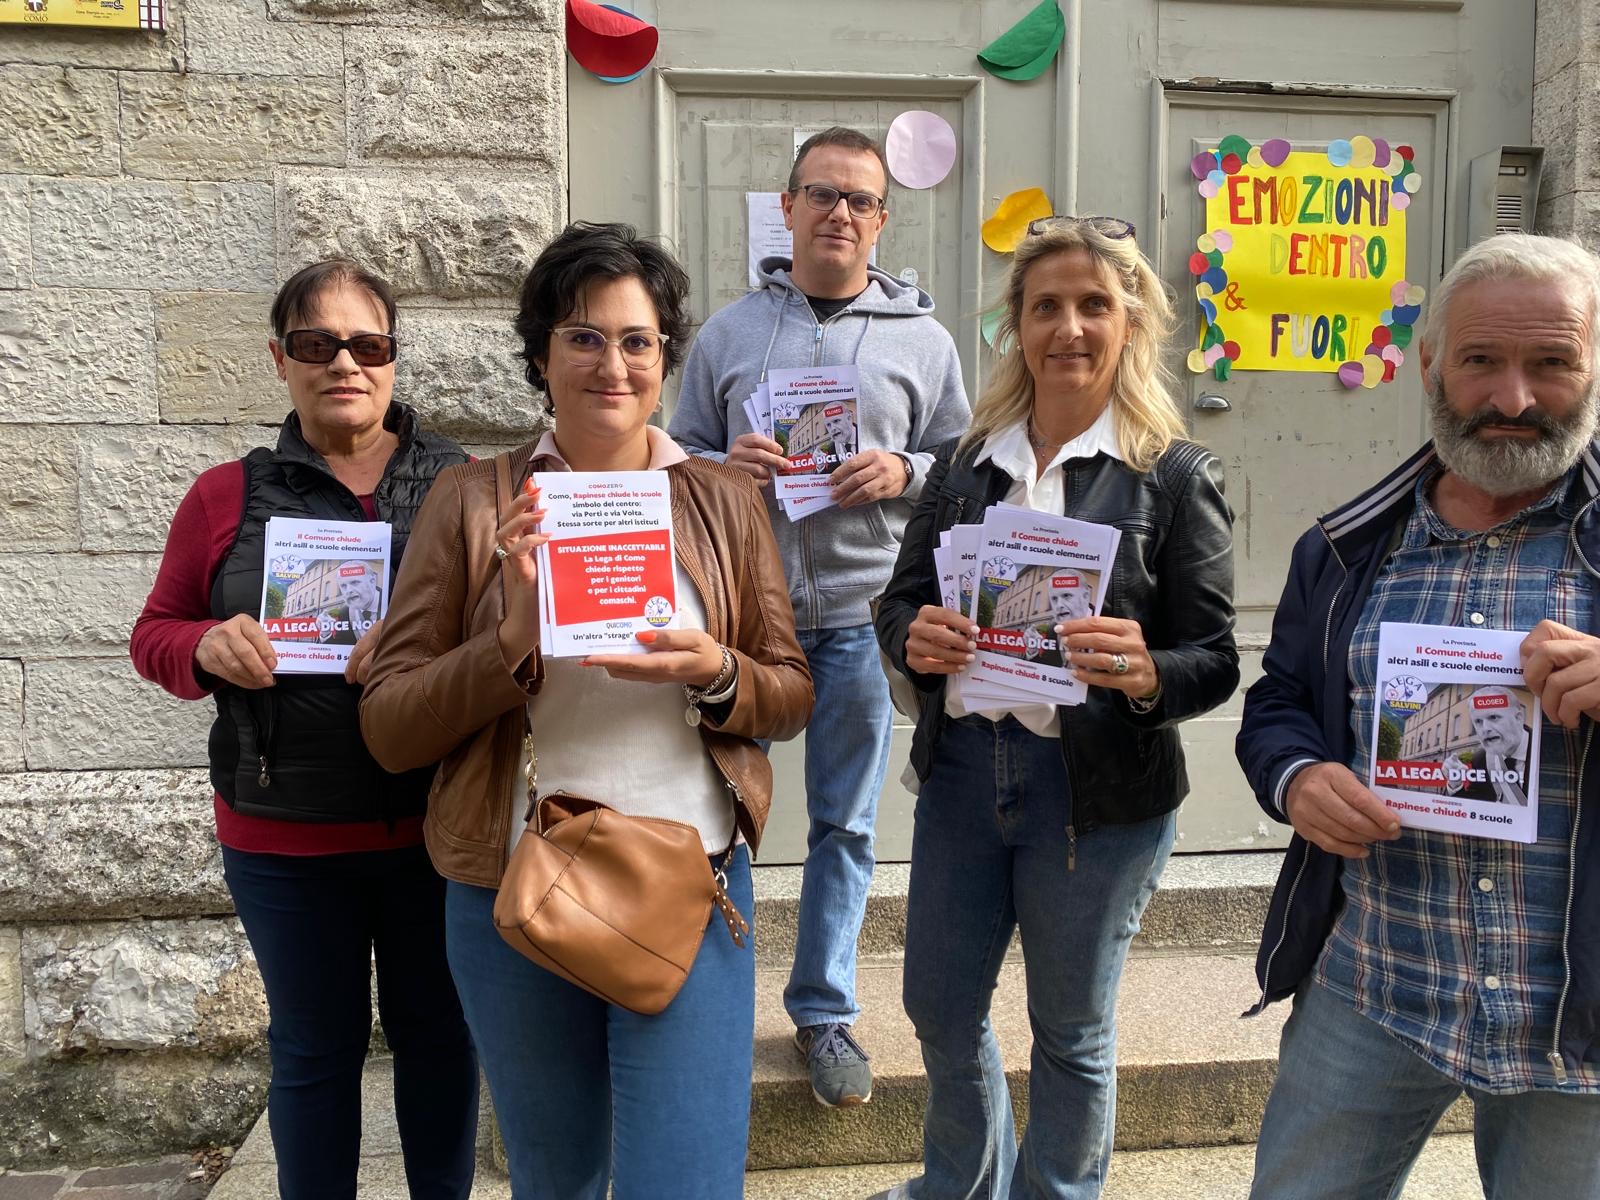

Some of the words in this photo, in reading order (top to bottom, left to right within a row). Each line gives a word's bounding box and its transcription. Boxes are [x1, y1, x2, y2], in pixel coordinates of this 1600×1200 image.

[1227, 176, 1389, 226] EMOZIONI
[1270, 233, 1387, 279] DENTRO
[1225, 281, 1248, 311] &
[1271, 314, 1360, 362] FUORI
[792, 458, 814, 468] LEGA
[816, 454, 836, 464] DICE
[1018, 533, 1051, 543] Comune
[1052, 537, 1078, 547] chiude
[557, 545, 606, 554] SITUAZIONE
[1029, 547, 1054, 555] scuole
[1056, 549, 1100, 561] elementari
[610, 575, 641, 584] genitori
[600, 596, 636, 605] comaschi.
[264, 623, 281, 633] LA
[284, 622, 317, 632] LEGA
[321, 621, 349, 632] DICE
[976, 634, 991, 642] LA
[994, 634, 1025, 647] LEGA
[1028, 638, 1056, 650] DICE
[1425, 647, 1466, 657] Comune
[1468, 650, 1503, 660] chiude
[1388, 657, 1408, 666] altri
[1411, 659, 1429, 667] asili
[1440, 662, 1472, 670] scuole
[1475, 663, 1524, 675] elementa
[981, 661, 1013, 674] Rapinese
[1015, 670, 1040, 680] chiude
[1048, 676, 1073, 687] scuole
[1389, 677, 1423, 692] LEGA
[1390, 701, 1421, 710] SALVINI
[1376, 766, 1397, 778] LA
[1402, 767, 1445, 780] LEGA
[1449, 769, 1486, 782] DICE
[1491, 770, 1524, 784] NO!
[1385, 800, 1430, 813] Rapinese
[1433, 806, 1467, 818] chiude
[1480, 814, 1513, 824] scuole
